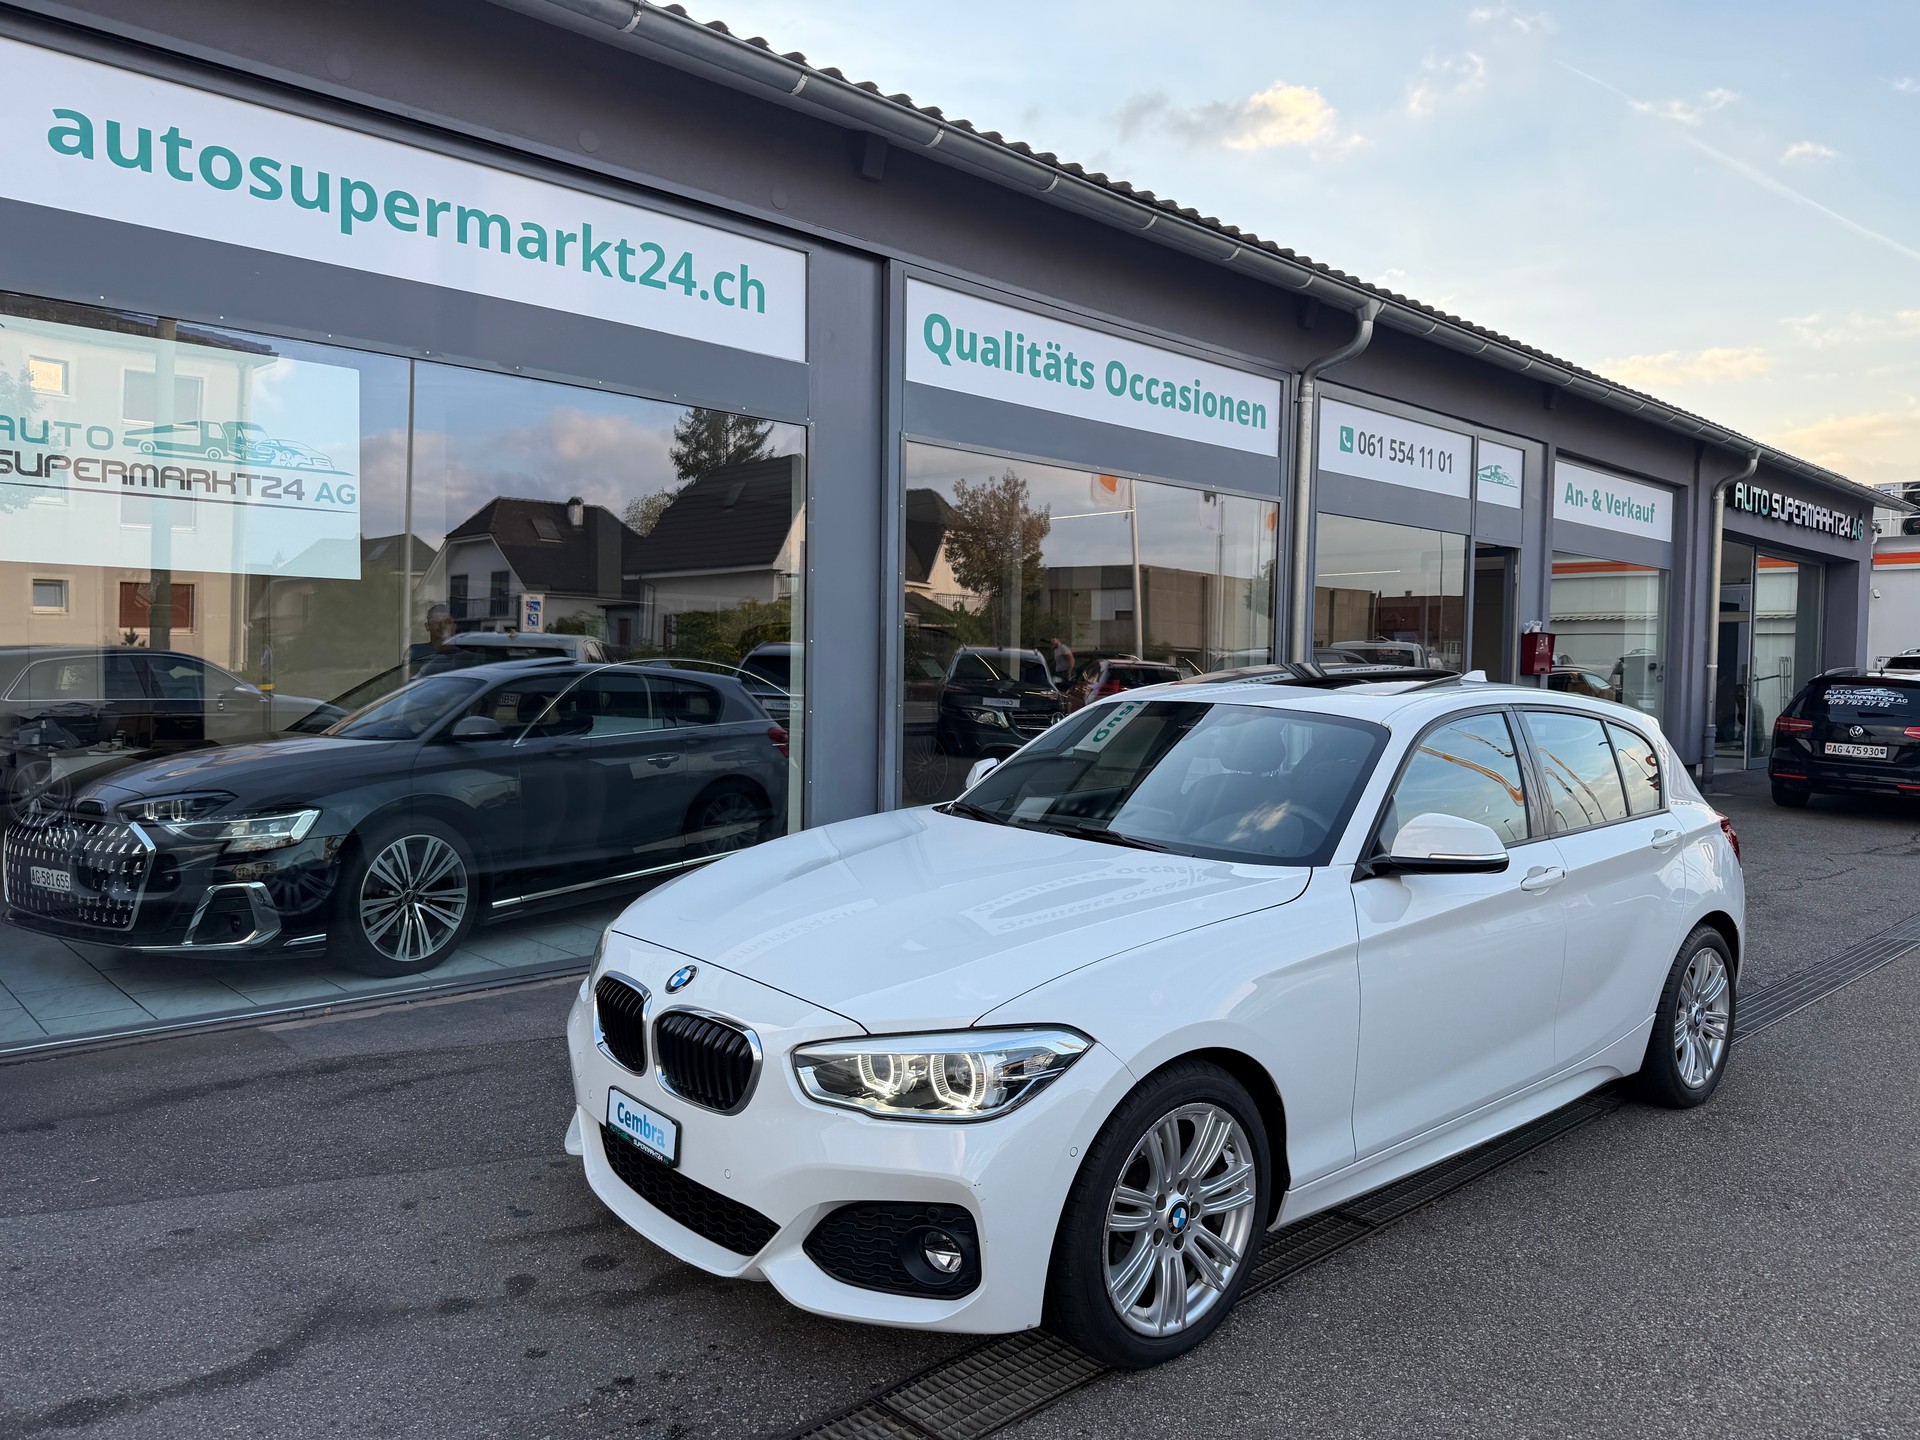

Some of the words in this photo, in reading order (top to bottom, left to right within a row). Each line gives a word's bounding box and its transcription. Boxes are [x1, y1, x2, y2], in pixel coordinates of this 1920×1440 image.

[47, 106, 767, 314] autosupermarkt24.ch
[923, 313, 1095, 389] Qualitäts
[1105, 360, 1267, 429] Occasionen
[0, 415, 114, 451] AUTO
[1358, 431, 1383, 459] 061
[1389, 438, 1415, 466] 554
[1419, 446, 1433, 470] 11
[1438, 450, 1452, 474] 01
[315, 482, 356, 504] AG
[1564, 482, 1588, 508] An-
[1591, 489, 1602, 512] &
[1605, 492, 1655, 523] Verkauf
[1735, 482, 1769, 516] AUTO
[1771, 493, 1851, 538] SUPERMARKT24
[1851, 518, 1864, 541] AG
[617, 1101, 666, 1149] Cembra
